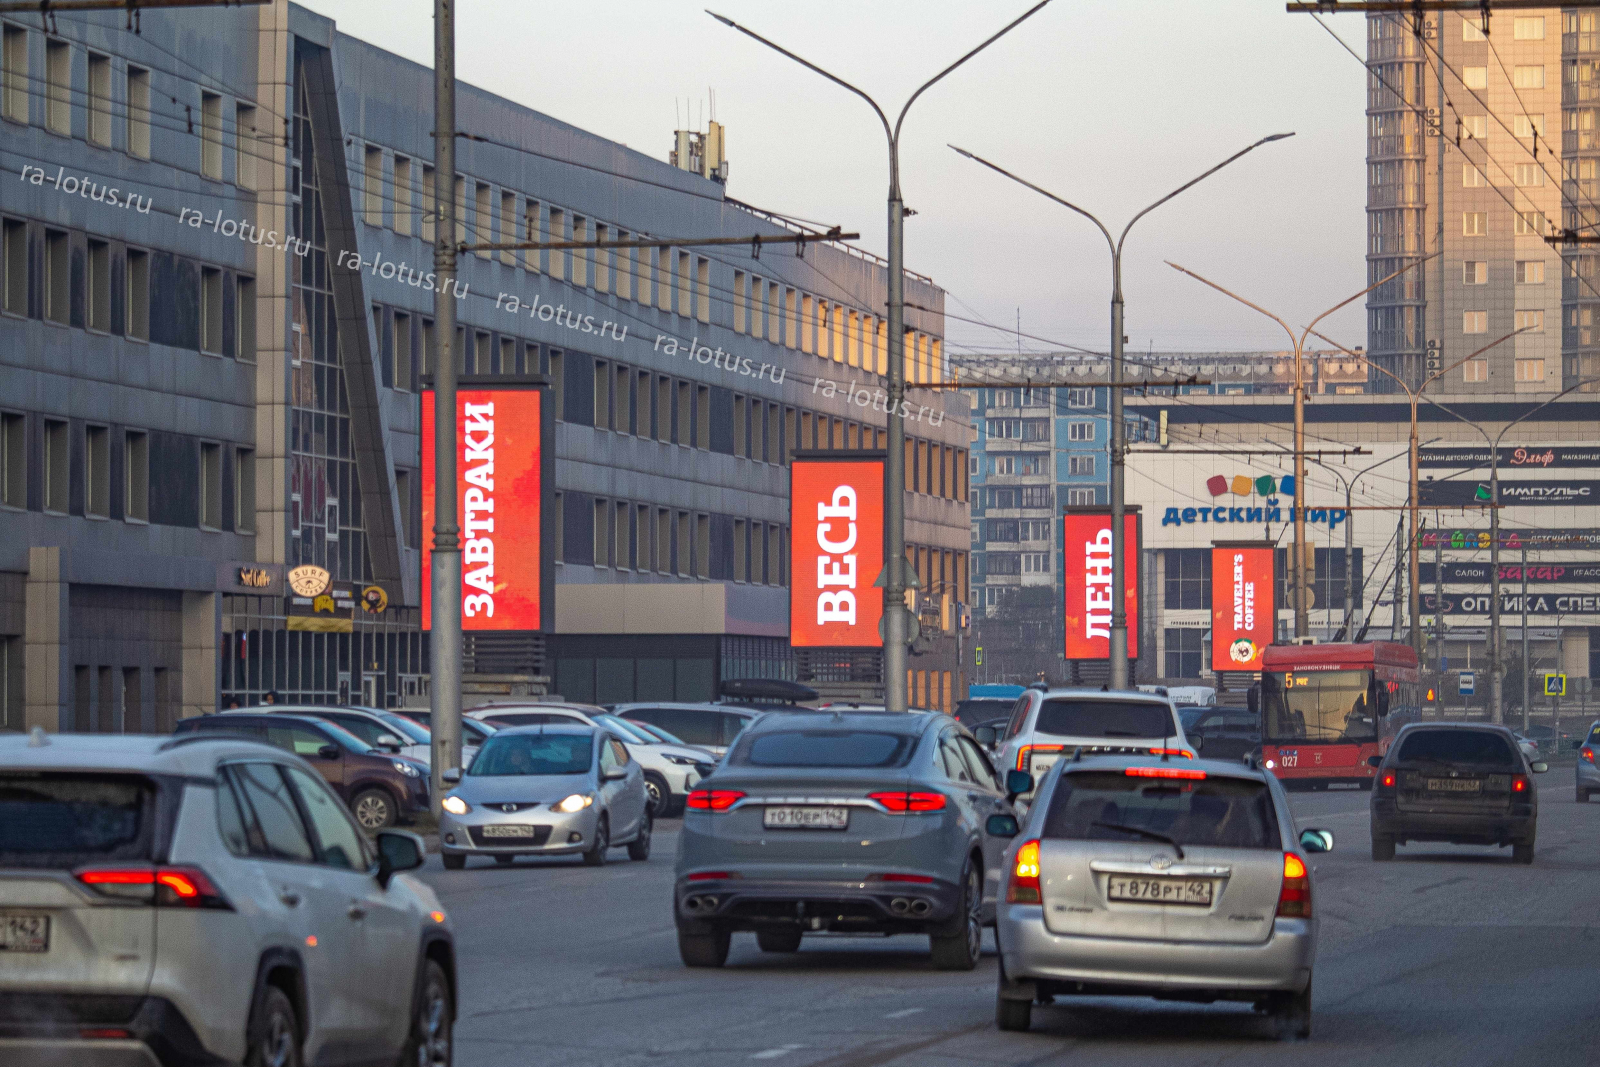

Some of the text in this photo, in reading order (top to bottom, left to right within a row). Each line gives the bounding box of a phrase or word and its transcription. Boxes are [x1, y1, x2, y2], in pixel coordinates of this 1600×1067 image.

[1445, 453, 1474, 462] ДЕТСКОЙ
[1502, 487, 1591, 496] ИМПУЛЬС
[464, 401, 495, 618] ЗАВТРАКИ
[1162, 498, 1281, 526] детский
[816, 484, 857, 625] ВЕСЬ
[294, 569, 325, 579] SURF
[1456, 569, 1485, 577] САЛОН
[1233, 553, 1243, 630] TRAVELER'S
[1244, 581, 1255, 630] COFFEE
[1461, 596, 1549, 612] ОПИКА
[1285, 672, 1293, 688] 5
[1281, 756, 1298, 767] 027
[1117, 881, 1205, 897] Т878РТ 42
